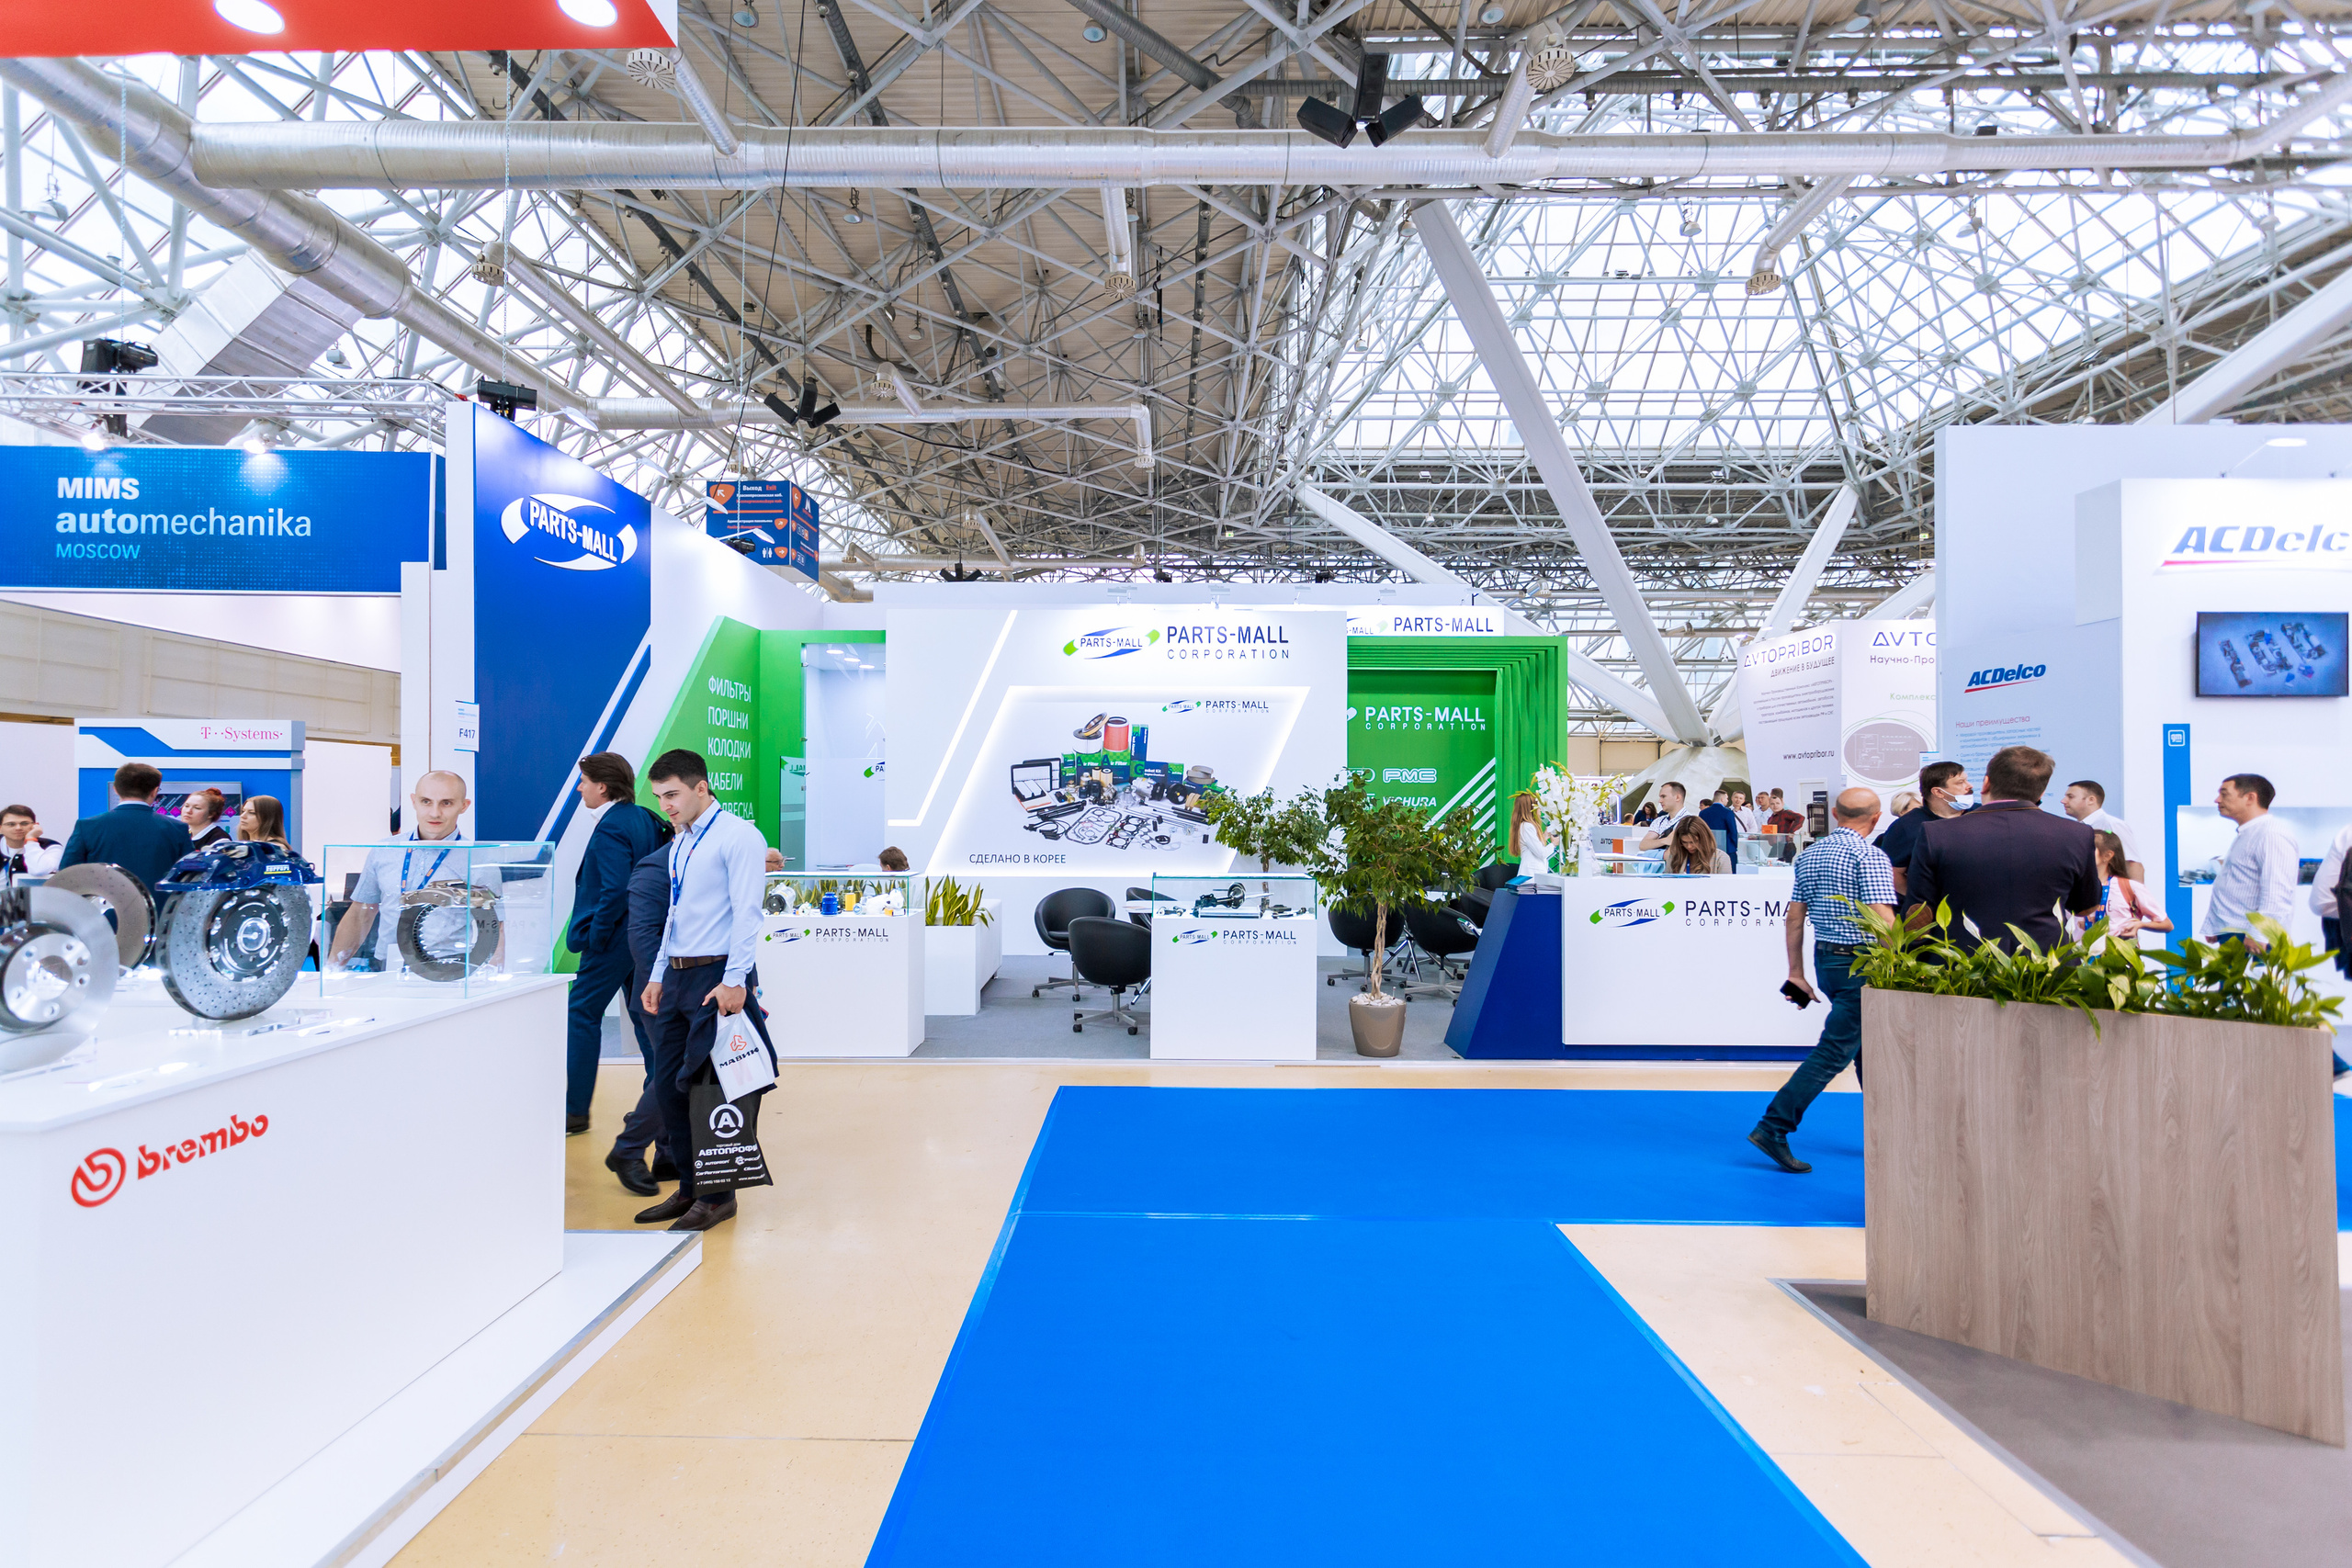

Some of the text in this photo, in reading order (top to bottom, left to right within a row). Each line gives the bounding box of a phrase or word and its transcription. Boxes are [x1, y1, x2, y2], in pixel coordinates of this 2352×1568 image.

[57, 477, 140, 500] MIMS
[55, 507, 311, 536] automechanika
[529, 500, 617, 562] PARTS-MALL
[55, 543, 140, 559] MOSCOW
[1394, 617, 1494, 632] PARTS-MALL
[1080, 637, 1143, 648] PARTS-MALL
[1167, 626, 1290, 644] PARTS-MALL
[1167, 649, 1290, 660] CORPORATION
[1744, 635, 1833, 668] AVTOPRIBOR
[1770, 656, 1835, 678] ДВИЖЕНИЕ В БУДУЩЕЕ
[1967, 663, 2047, 687] ACDelco
[708, 675, 752, 703] ФИЛЬТРЫ
[1205, 701, 1269, 709] PARTS-MALL
[707, 705, 749, 730] ПОРШНИ
[1365, 706, 1486, 722] PARTS-MALL
[1955, 716, 2030, 728] Наши преимущества
[458, 728, 476, 739] F417
[1365, 722, 1486, 730] CORPORATION
[707, 737, 752, 761] КОЛОДКИ
[1782, 750, 1835, 761] www.avtopribor.ru
[708, 772, 743, 791] КАБЕЛИ
[1383, 768, 1437, 784] PMC
[969, 853, 1067, 865] СДЕЛАНО В КОРЕЕ
[1604, 908, 1660, 918] PARTS-MALL
[1685, 900, 1793, 917] PARTS-MA
[816, 928, 888, 937] PARTS-MALL
[1223, 931, 1296, 940] PARTS-MALL
[137, 1114, 269, 1180] brembo
